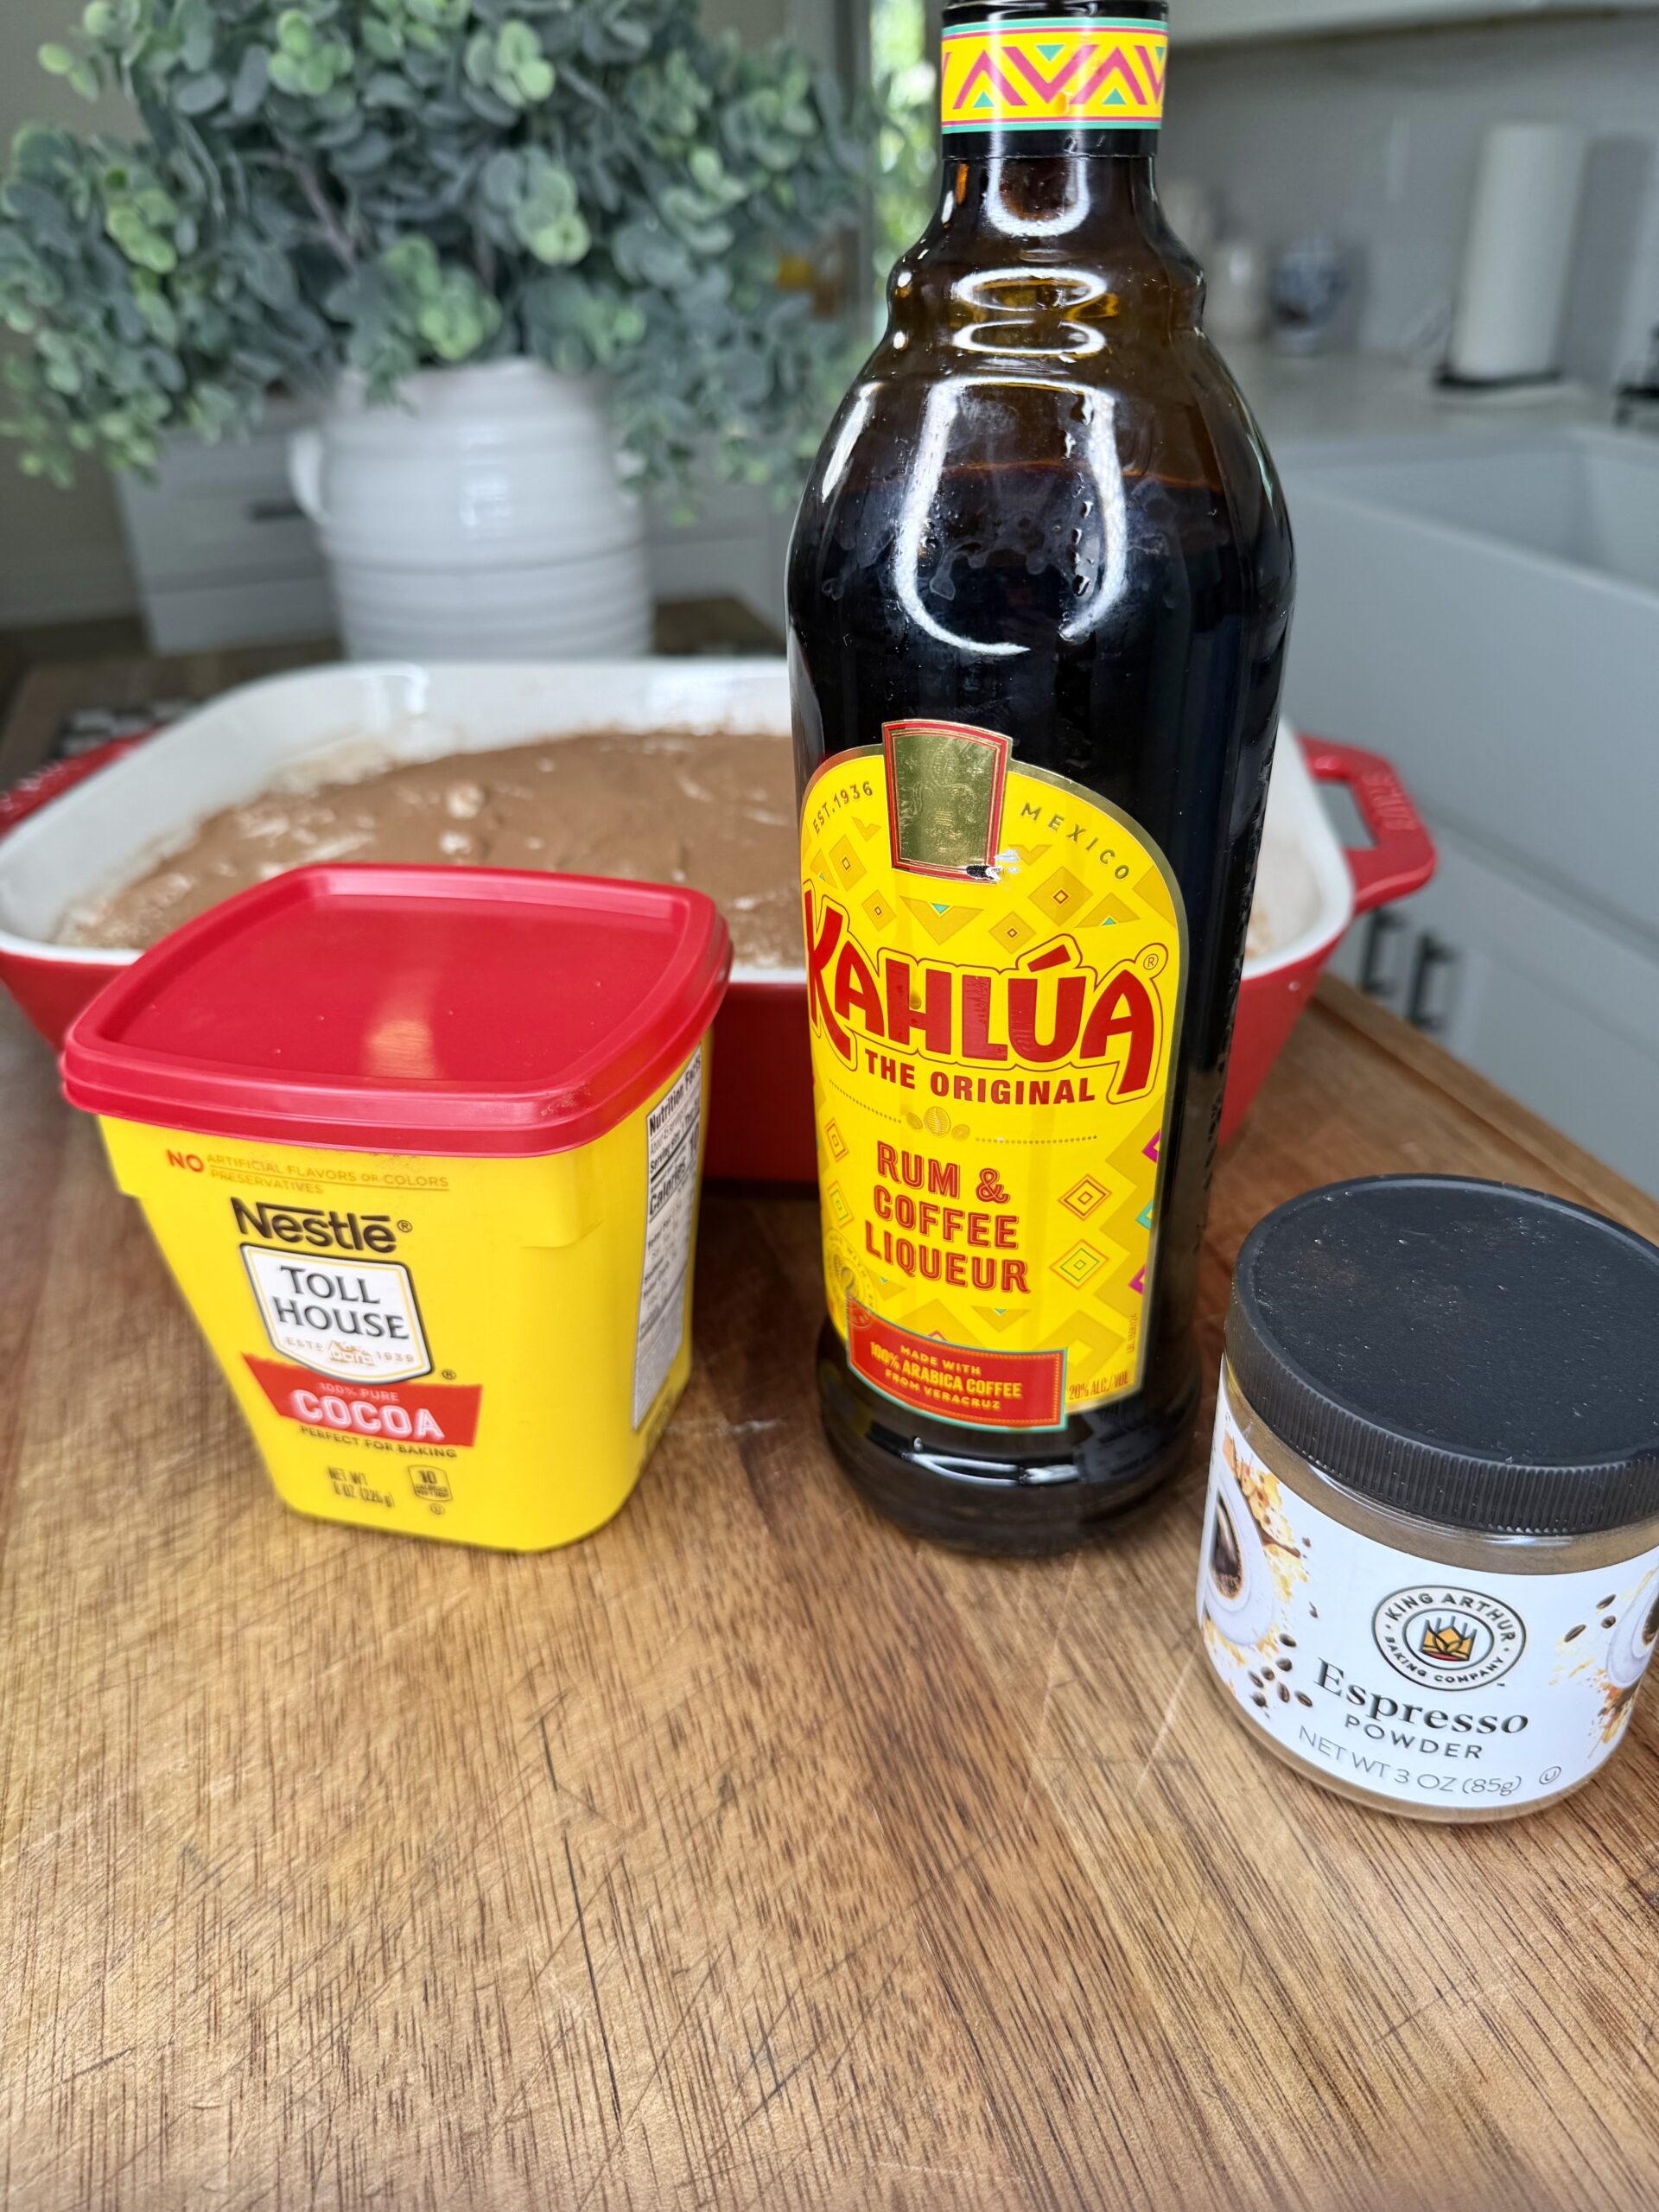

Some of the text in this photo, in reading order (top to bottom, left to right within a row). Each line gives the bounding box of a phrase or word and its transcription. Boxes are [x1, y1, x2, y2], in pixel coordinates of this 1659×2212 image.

[1020, 802, 1130, 880] MEXICO
[804, 890, 1155, 1096] KAHLÚA
[865, 1049, 1096, 1105] THE ORIGINAL
[650, 1083, 684, 1135] Nutrition
[167, 1149, 205, 1173] NO
[207, 1154, 283, 1174] ARTIFICIAL
[287, 1165, 357, 1182] FLAVORS
[383, 1174, 449, 1187] COLORS
[210, 1168, 324, 1194] PRESERVATIVES
[650, 1160, 686, 1216] Calories
[876, 1140, 1011, 1205] RUM &
[874, 1184, 1020, 1250] COFFEE
[865, 1220, 1031, 1294] LIQUEUR
[280, 1264, 380, 1305] TOLL
[271, 1295, 410, 1340] HOUSE
[870, 1342, 1022, 1398] 100% ARABICA COFFEE
[900, 1345, 982, 1376] MADE WITH
[318, 1382, 400, 1402] 100% PURE
[885, 1369, 1001, 1410] FROM VERACRUZ
[1069, 1382, 1089, 1400] 20%
[289, 1389, 445, 1442] COCOA
[300, 1426, 457, 1459] PERFECT FOR BAKING
[1384, 1592, 1516, 1643] KING ARTHUR
[1384, 1636, 1505, 1683] BAKING COMPANY
[1313, 1657, 1529, 1735] Espresso
[1299, 1725, 1522, 1796] NET WT 3 OZ (85g)
[1344, 1713, 1484, 1759] POWDER
